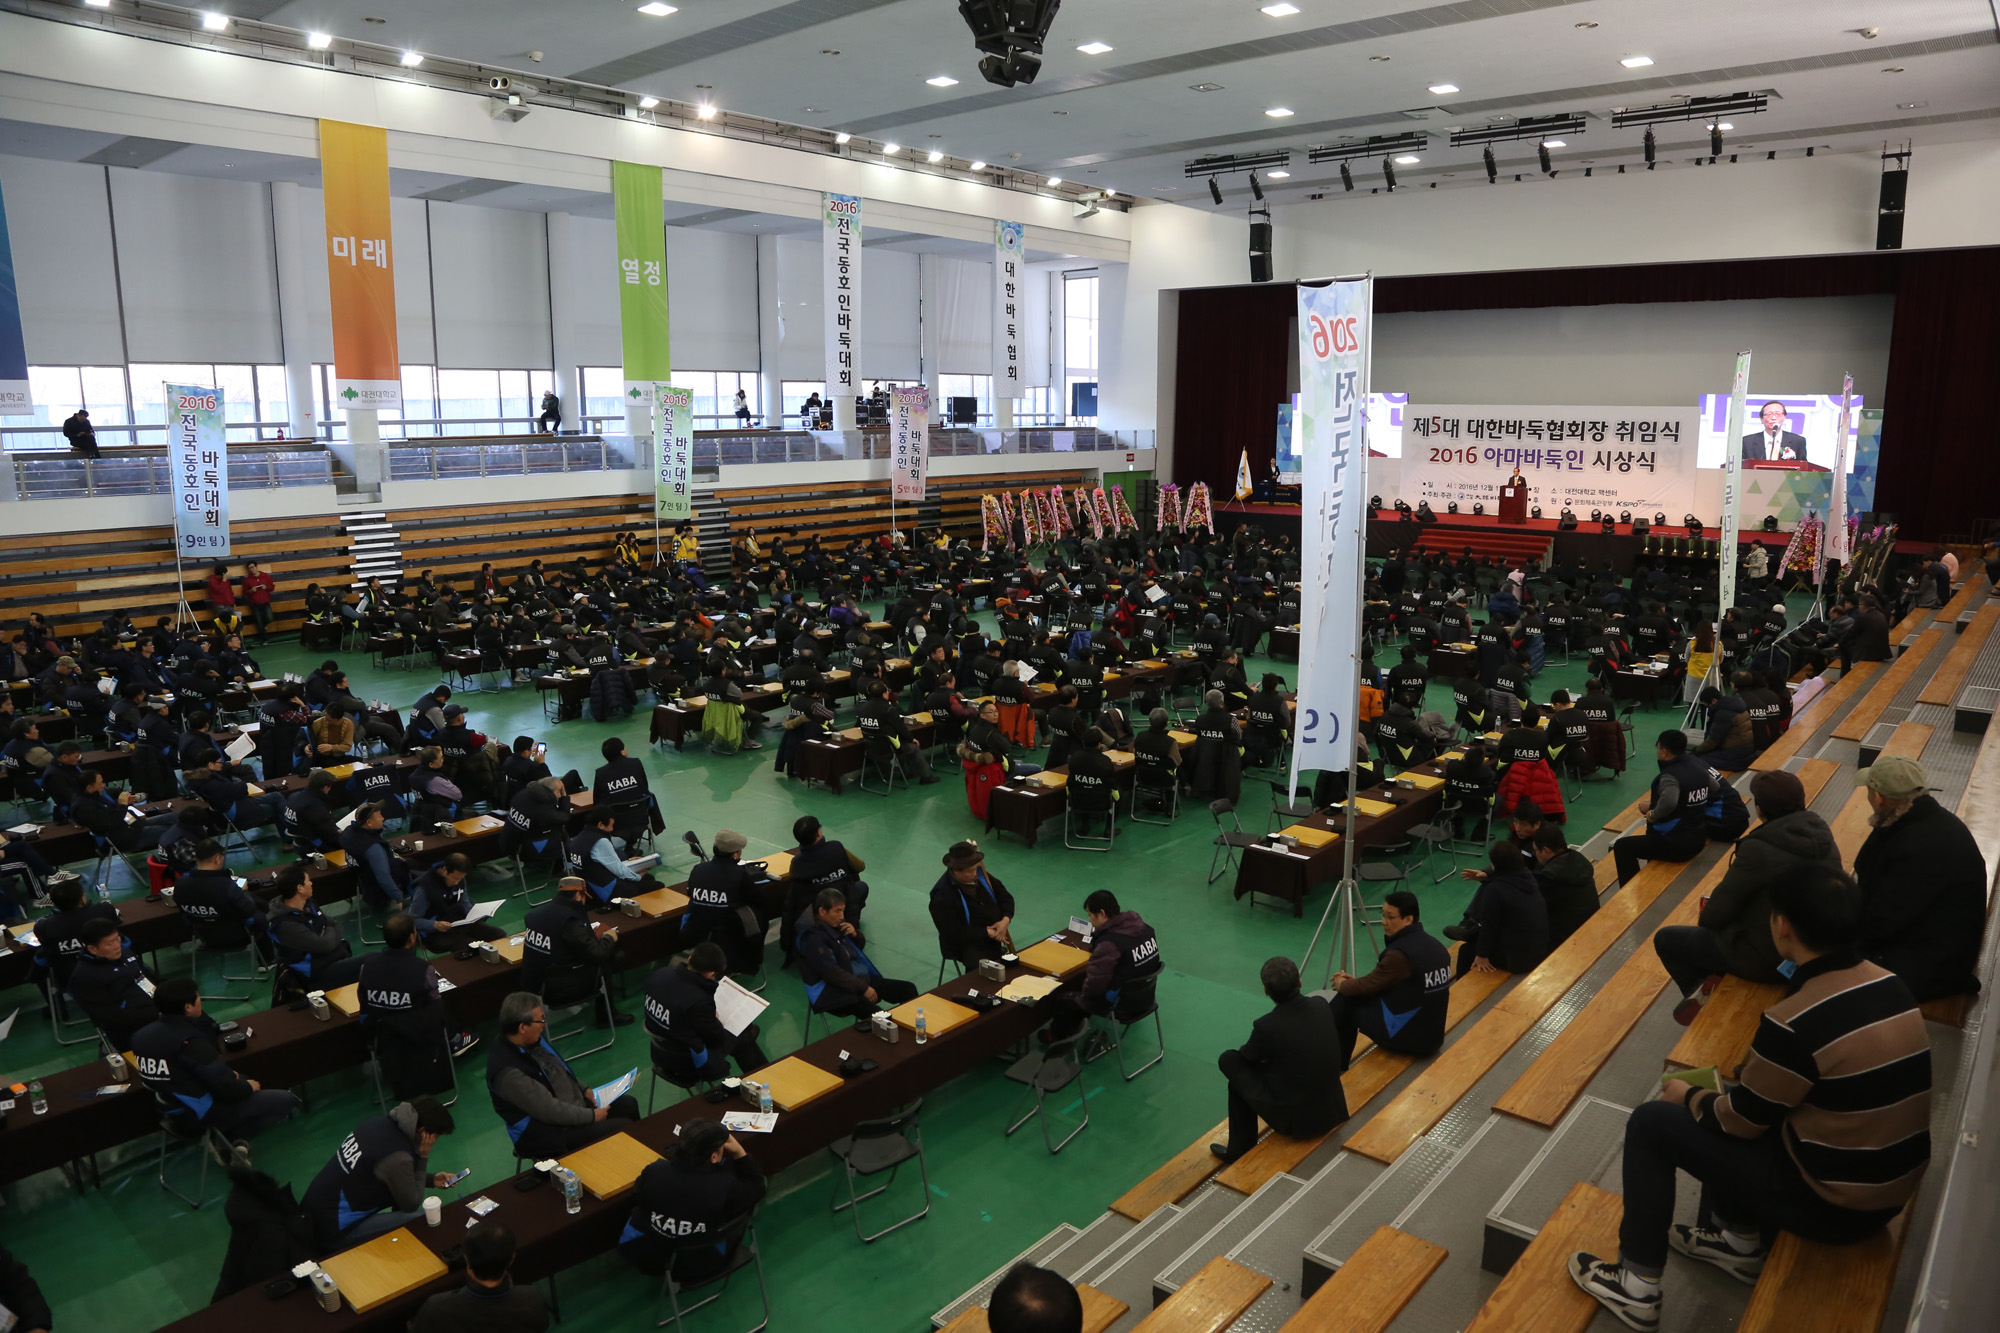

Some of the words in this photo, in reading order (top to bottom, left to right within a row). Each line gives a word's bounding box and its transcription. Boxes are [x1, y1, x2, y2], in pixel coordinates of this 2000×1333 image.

[830, 200, 857, 214] 2016
[332, 236, 387, 268] 미래
[622, 258, 660, 286] 열정
[1005, 262, 1017, 380] 대한바둑협회
[361, 390, 396, 399] 대전대학교
[664, 394, 688, 405] 2016
[899, 394, 922, 404] 2016
[180, 396, 216, 410] 2016
[1413, 416, 1459, 438] 제5대
[1468, 419, 1608, 442] 대한바둑협회장
[1615, 421, 1680, 442] 취임식
[910, 430, 922, 480] 바둑대회
[1430, 446, 1477, 464] 2016
[1484, 448, 1584, 470] 아마바둑인
[1592, 451, 1656, 472] 시상식
[674, 437, 688, 496] 바둑대회
[202, 451, 220, 526] 바둑대회
[1565, 488, 1596, 496] 대전대학교
[1045, 582, 1060, 592] KABA
[532, 608, 548, 617] KABA
[1444, 617, 1460, 626] KABA
[1639, 627, 1657, 635] KABA
[1197, 642, 1212, 650] KABA
[974, 669, 989, 679] KABA
[1072, 677, 1092, 685] KABA
[1402, 678, 1423, 686] KABA
[1497, 678, 1514, 688] KABA
[996, 695, 1017, 704] KABA
[1252, 711, 1273, 720] KABA
[1585, 709, 1607, 718] KABA
[860, 717, 879, 727] KABA
[1201, 730, 1224, 738] KABA
[1379, 723, 1397, 735] KABA
[1566, 726, 1587, 735] KABA
[1514, 749, 1540, 758] KABA
[364, 775, 390, 787] KABA
[607, 776, 637, 791] KABA
[1075, 775, 1102, 784] KABA
[508, 807, 531, 829] KABA
[692, 888, 727, 903] KABA
[182, 905, 218, 916] KABA
[525, 928, 550, 949] KABA
[58, 938, 85, 951] KA
[1132, 938, 1158, 962] KABA
[367, 990, 411, 1005] KABA
[645, 994, 670, 1025] KABA
